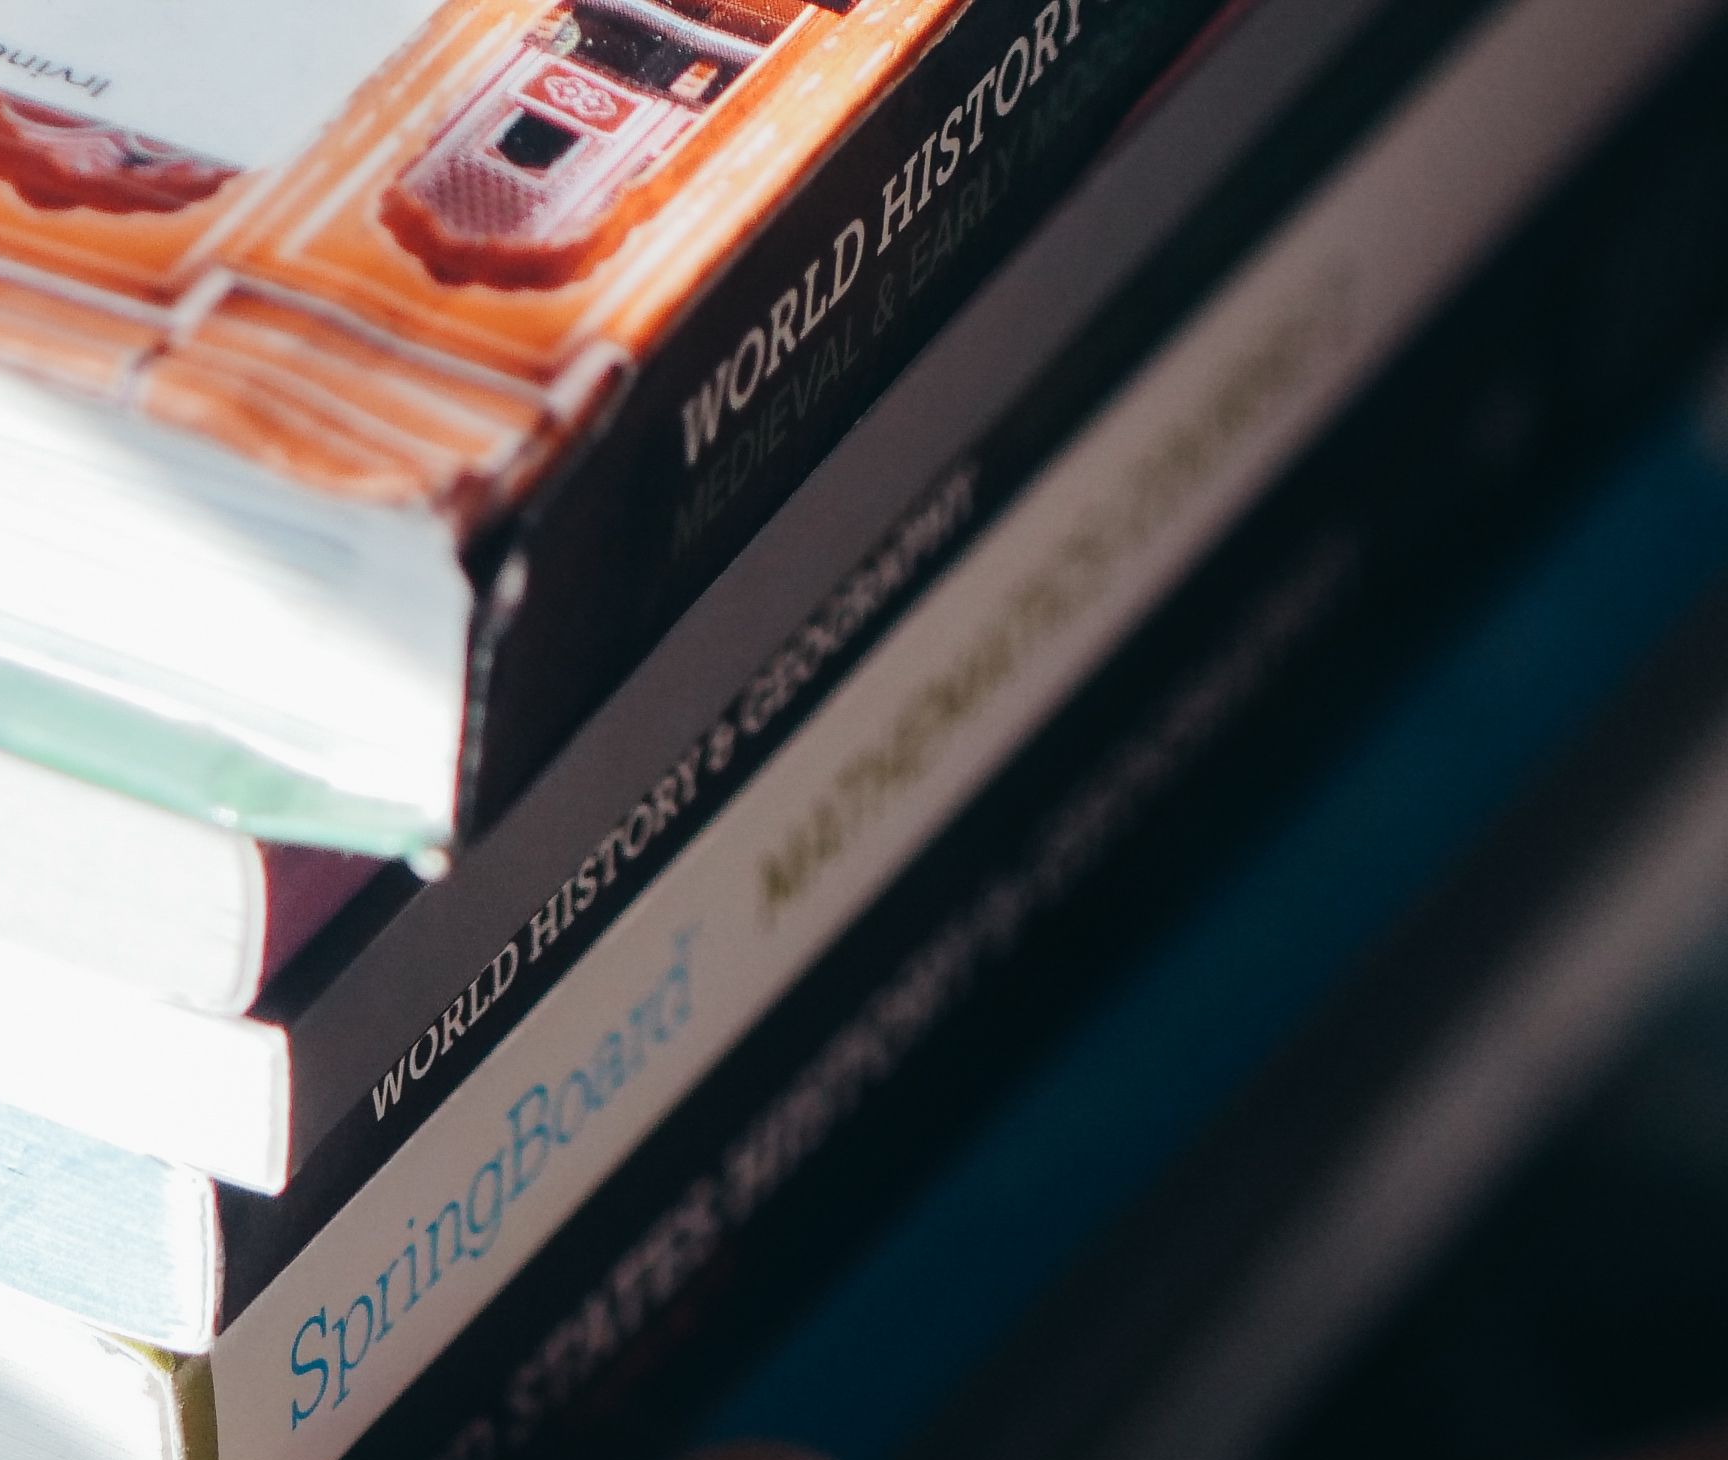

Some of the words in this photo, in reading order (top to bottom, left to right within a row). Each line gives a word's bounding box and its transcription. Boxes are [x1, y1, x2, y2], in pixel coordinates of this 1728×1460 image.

[672, 312, 860, 560] MEDIEVAL
[871, 273, 896, 337] &
[907, 127, 1024, 292] EARLY
[680, 217, 866, 467] WORLD
[371, 942, 520, 1122] WORLD
[527, 742, 702, 964] HISTORY
[706, 716, 740, 775] &
[739, 466, 978, 736] GEOGRAPHY
[289, 926, 696, 1431] SpringBoard
